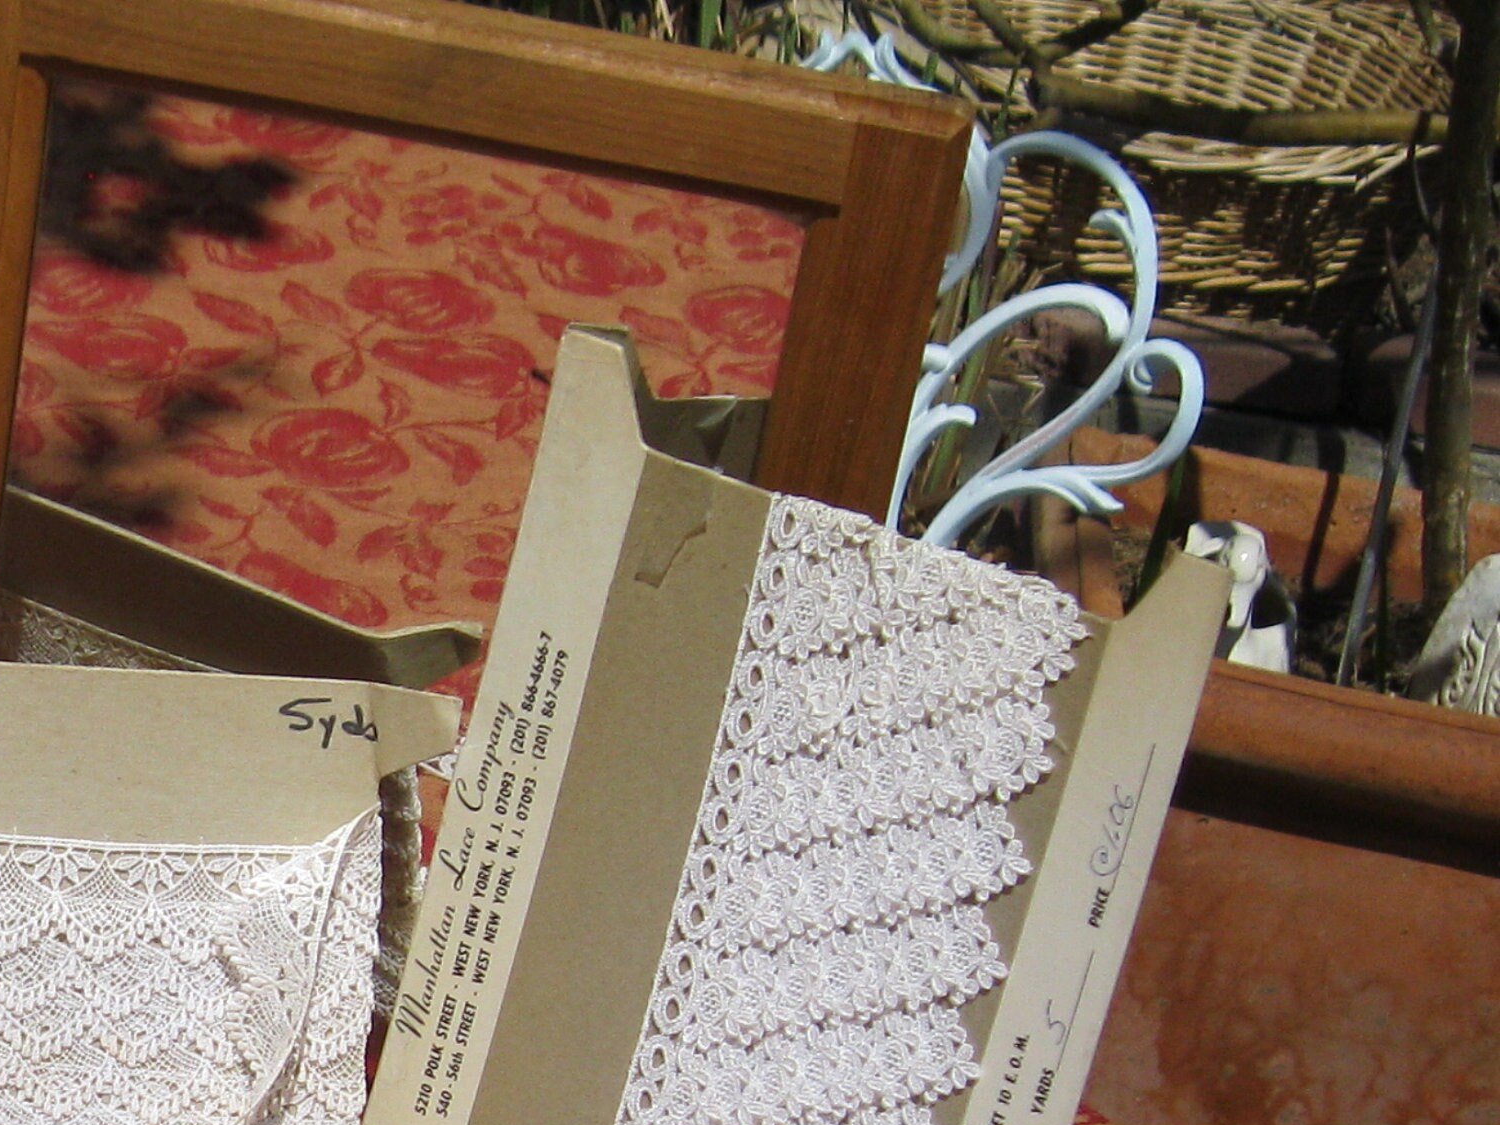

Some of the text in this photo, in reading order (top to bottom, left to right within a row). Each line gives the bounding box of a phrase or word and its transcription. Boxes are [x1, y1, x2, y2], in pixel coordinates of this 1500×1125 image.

[541, 650, 568, 718] 867-4079
[532, 725, 552, 759] (201)
[516, 778, 536, 820] 07093
[505, 844, 519, 858] N.
[395, 702, 514, 1038] Manhattan Lace Company
[415, 1084, 432, 1115] 5210
[425, 1045, 443, 1078] POLK
[436, 994, 456, 1039] STREET
[453, 942, 471, 976] WEST
[464, 905, 481, 936] NEW
[485, 837, 499, 852] N.
[495, 772, 515, 815] 07093
[510, 719, 530, 754] (201)
[522, 631, 551, 712] 866-4666-7
[484, 911, 500, 943] NEW
[472, 948, 490, 983] WEST
[1031, 1069, 1054, 1113] YARDS
[1089, 888, 1109, 927] PRICE
[456, 1002, 476, 1046] STREET
[1013, 1032, 1029, 1051] M.
[446, 1053, 463, 1081] 56th
[1009, 1054, 1023, 1069] O.
[436, 1091, 452, 1117] 540
[999, 1090, 1011, 1104] 10
